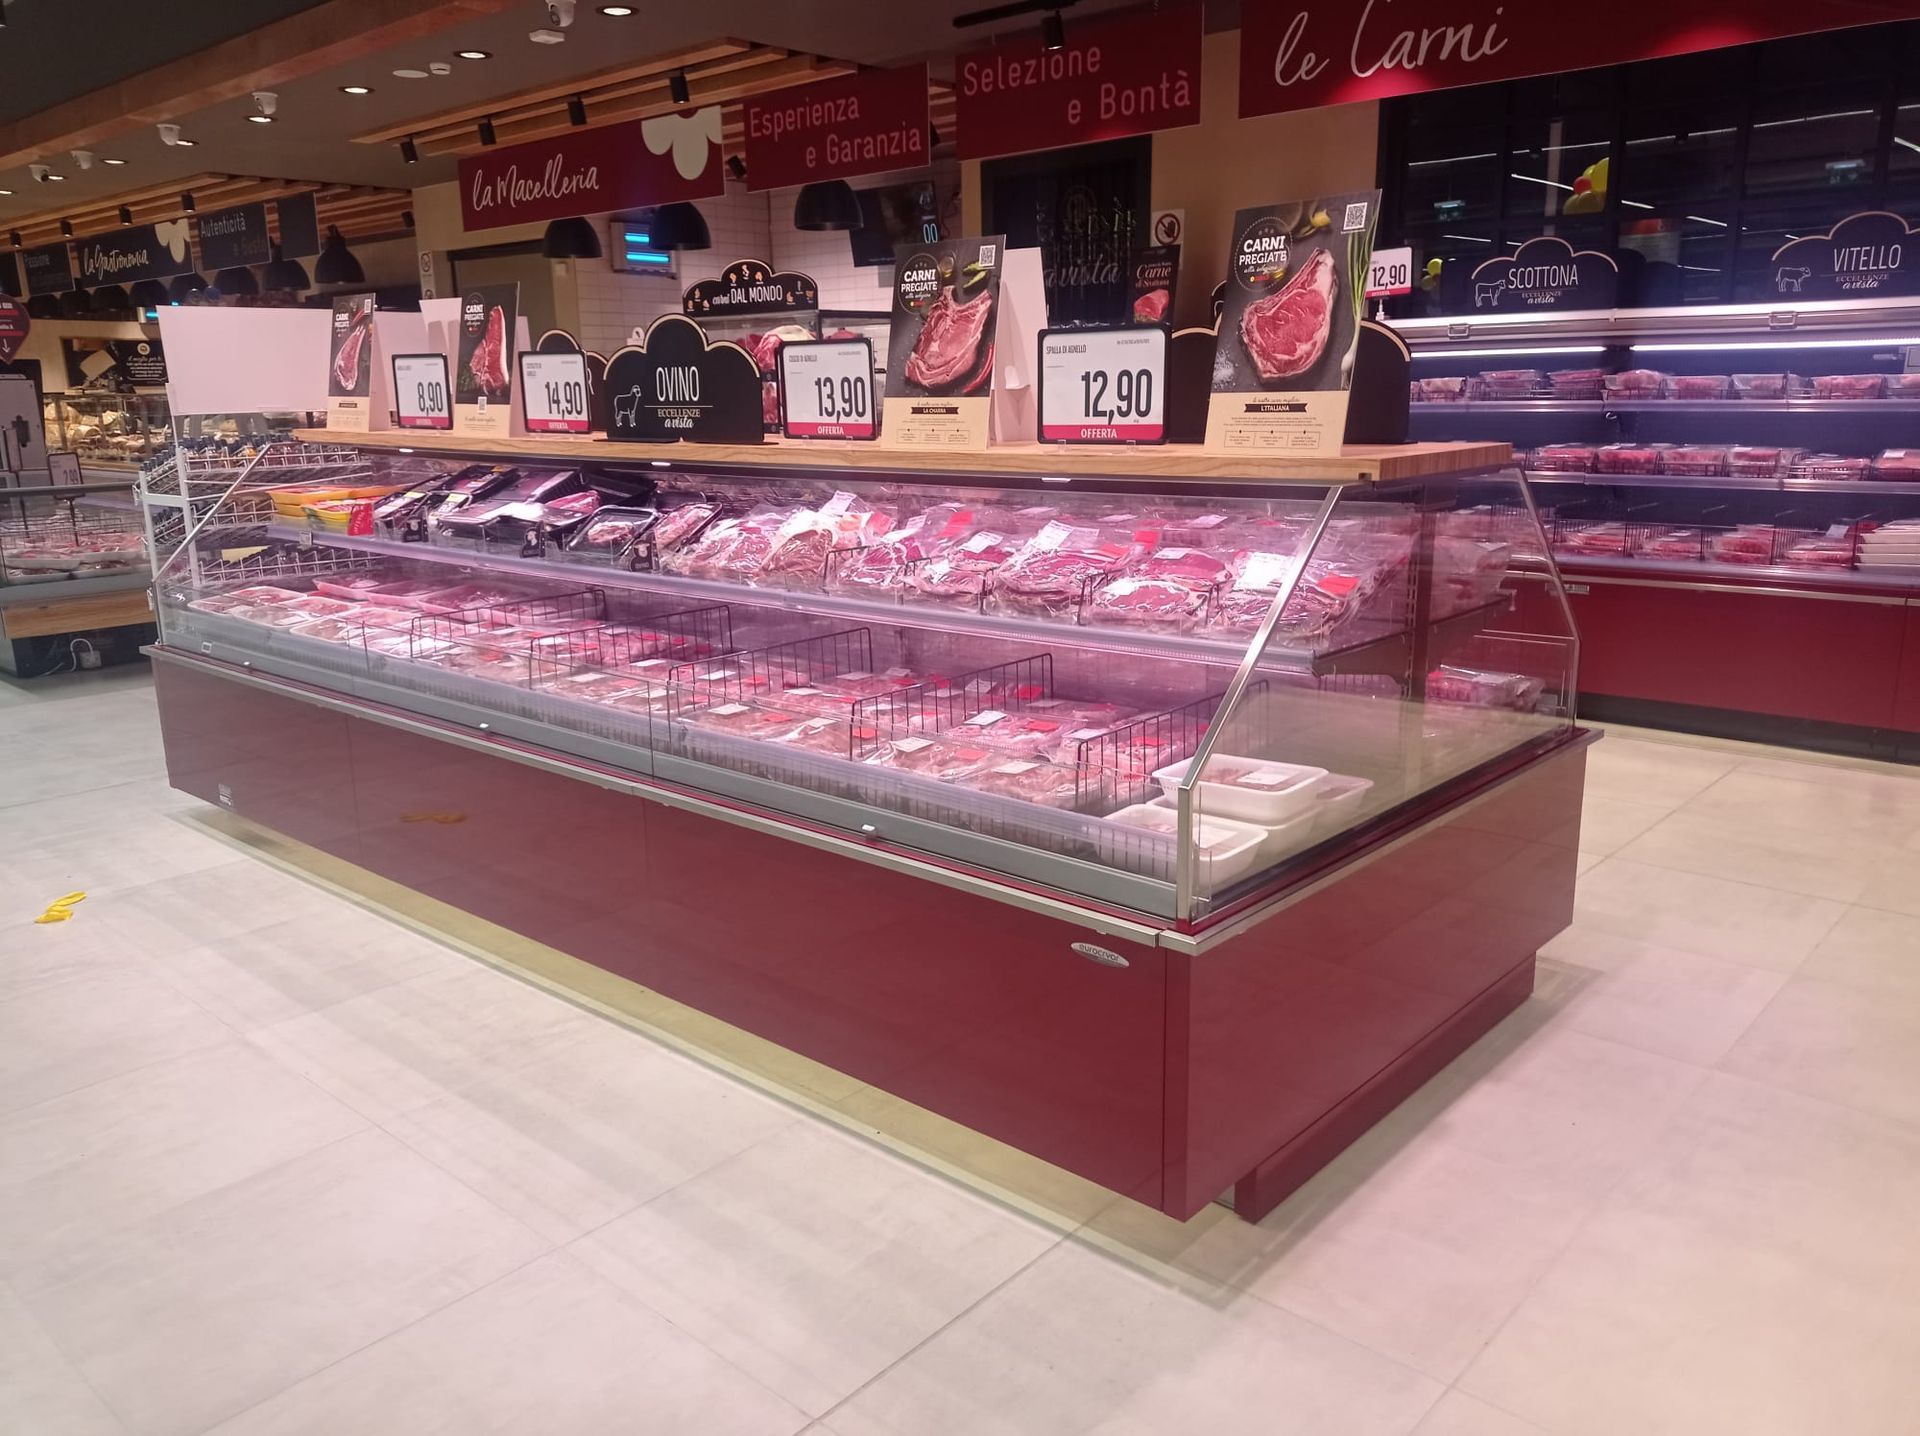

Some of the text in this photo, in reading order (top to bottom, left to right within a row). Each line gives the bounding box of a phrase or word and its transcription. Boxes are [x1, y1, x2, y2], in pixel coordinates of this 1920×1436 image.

[1275, 0, 1508, 86] le Carni
[963, 46, 1101, 96] Selezione
[1068, 70, 1190, 124] e Bontà
[750, 96, 860, 142] Esperienza
[806, 121, 921, 168] e Garanzia
[473, 153, 599, 211] la Macelleria
[200, 211, 247, 238] Autenticità
[1243, 235, 1286, 253] CARNI
[84, 244, 149, 281] la Gastronomia
[1136, 263, 1172, 279] Carne
[1239, 250, 1287, 266] PREGIATE
[1834, 244, 1901, 272] VITELLO
[901, 281, 938, 293] PREGIATE
[904, 268, 937, 283] CARNI
[1372, 264, 1407, 290] 12,90
[1508, 264, 1578, 289] SCOTTONA
[1835, 273, 1889, 282] ECCELLENZE
[730, 288, 748, 304] DAL
[749, 285, 783, 303] MONDO
[656, 366, 700, 402] OVINO
[1081, 368, 1153, 425] 12,90
[417, 382, 443, 416] 8,90
[545, 381, 583, 420] 14,90
[815, 376, 866, 424] 13,90
[657, 408, 701, 418] ECCELLENZE
[664, 415, 694, 429] a vista
[817, 426, 844, 435] OFFERTA
[1081, 428, 1117, 438] OFFERTA
